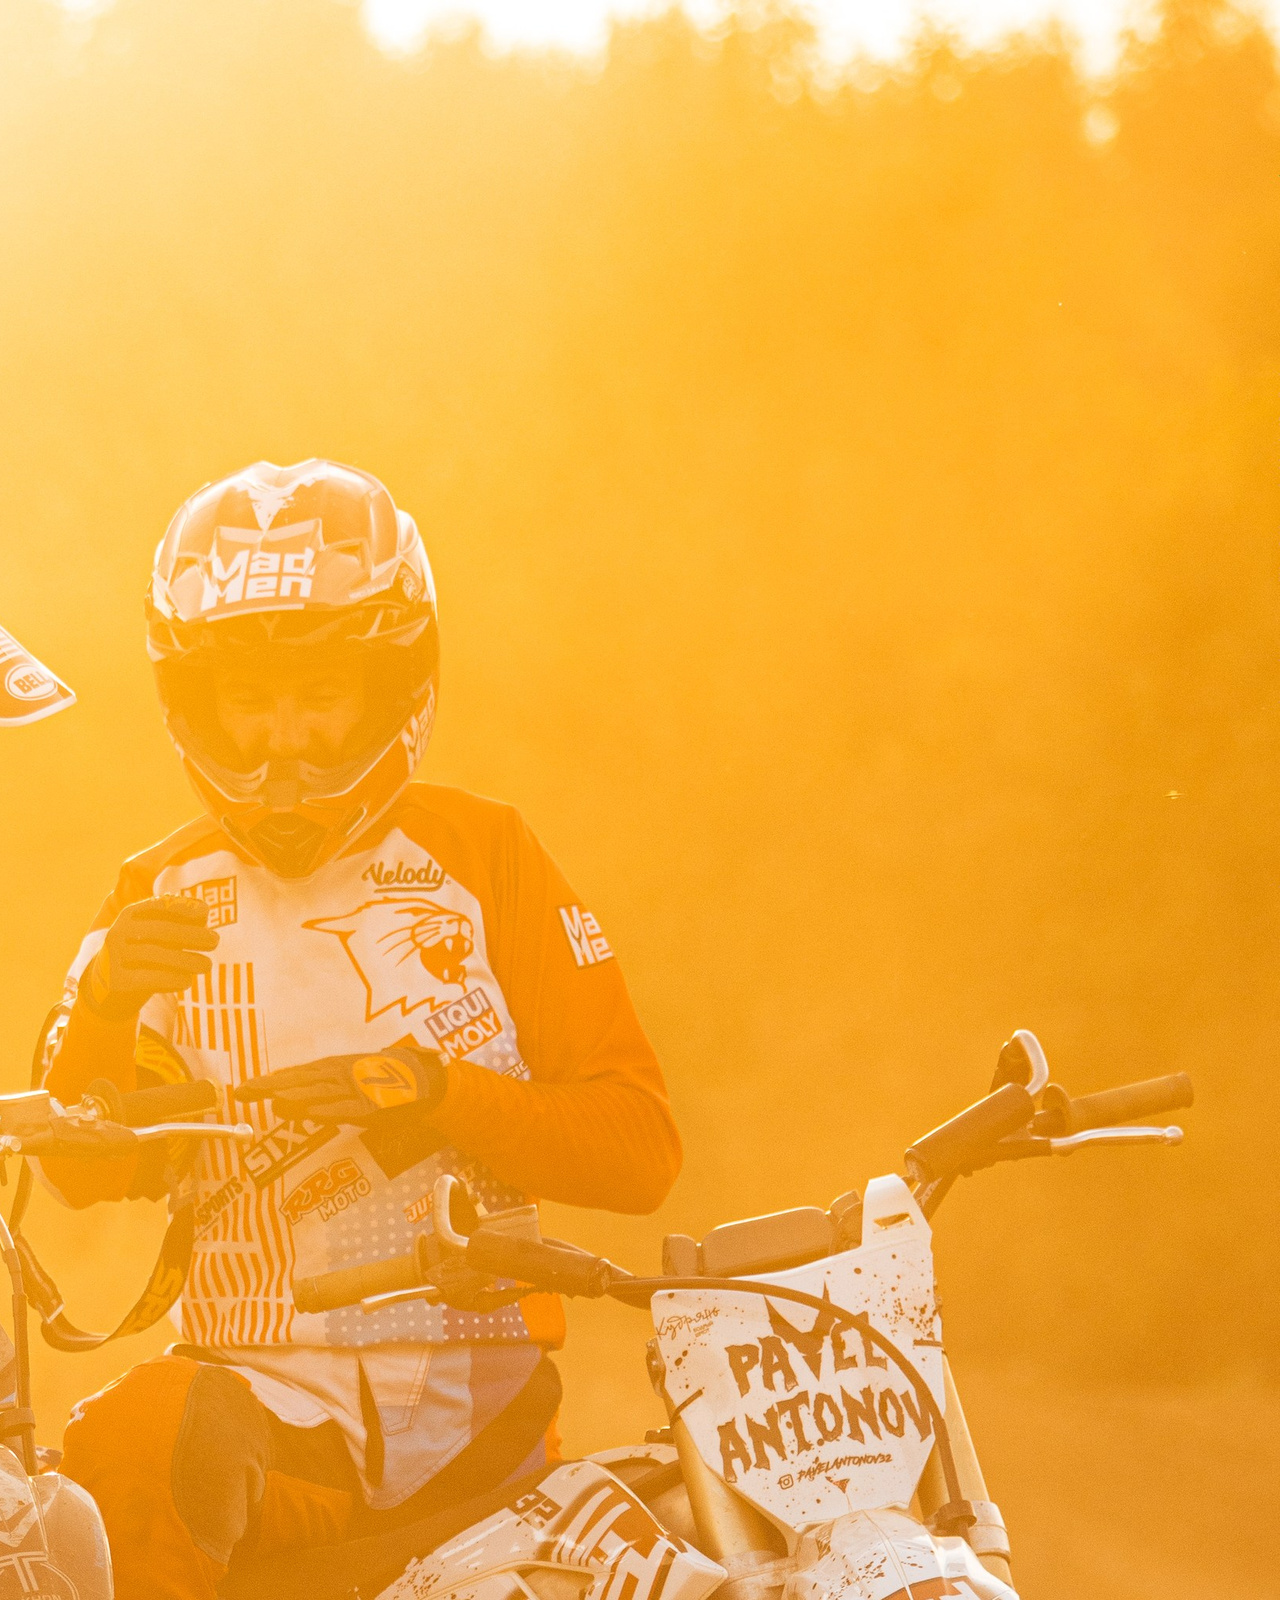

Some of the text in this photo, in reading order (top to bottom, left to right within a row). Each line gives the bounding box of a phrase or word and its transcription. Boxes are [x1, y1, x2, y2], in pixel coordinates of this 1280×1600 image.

[210, 547, 317, 581] Mad
[200, 575, 313, 612] Men
[13, 671, 51, 695] BELL
[361, 859, 447, 889] Velody
[206, 904, 235, 928] en
[559, 904, 601, 938] Ma
[573, 934, 613, 968] Me
[430, 991, 488, 1038] LIQUI
[443, 1014, 500, 1060] MOLY
[319, 1177, 372, 1222] MOTO
[724, 1290, 888, 1398] PAVEL
[717, 1383, 933, 1483] ANTONOV
[797, 1453, 893, 1482] PAVELANTONOV32
